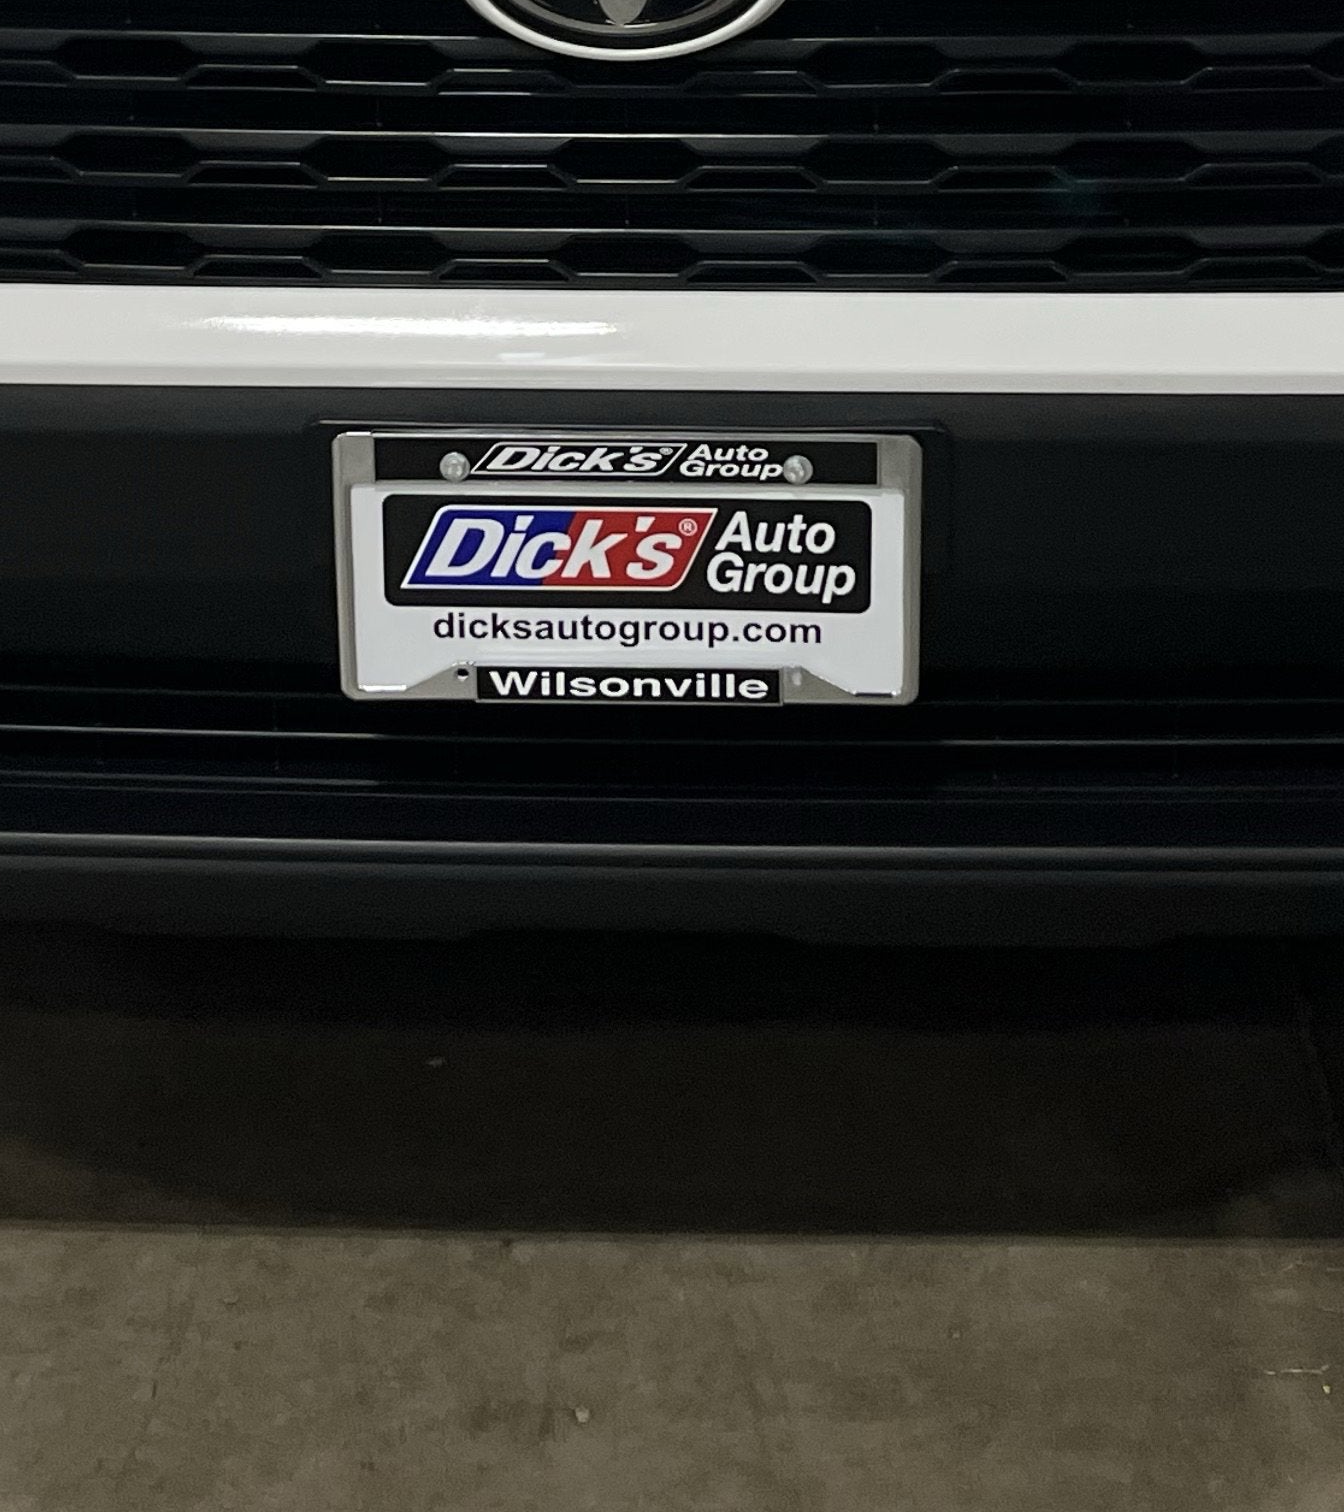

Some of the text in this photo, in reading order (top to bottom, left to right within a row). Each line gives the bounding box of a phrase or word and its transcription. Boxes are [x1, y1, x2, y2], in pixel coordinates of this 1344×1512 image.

[687, 443, 769, 462] Auto
[678, 460, 784, 481] Group
[714, 510, 837, 555] Auto
[706, 551, 857, 605] Group
[432, 611, 823, 648] dicksautogroup.com
[488, 669, 770, 700] Wilsonville
